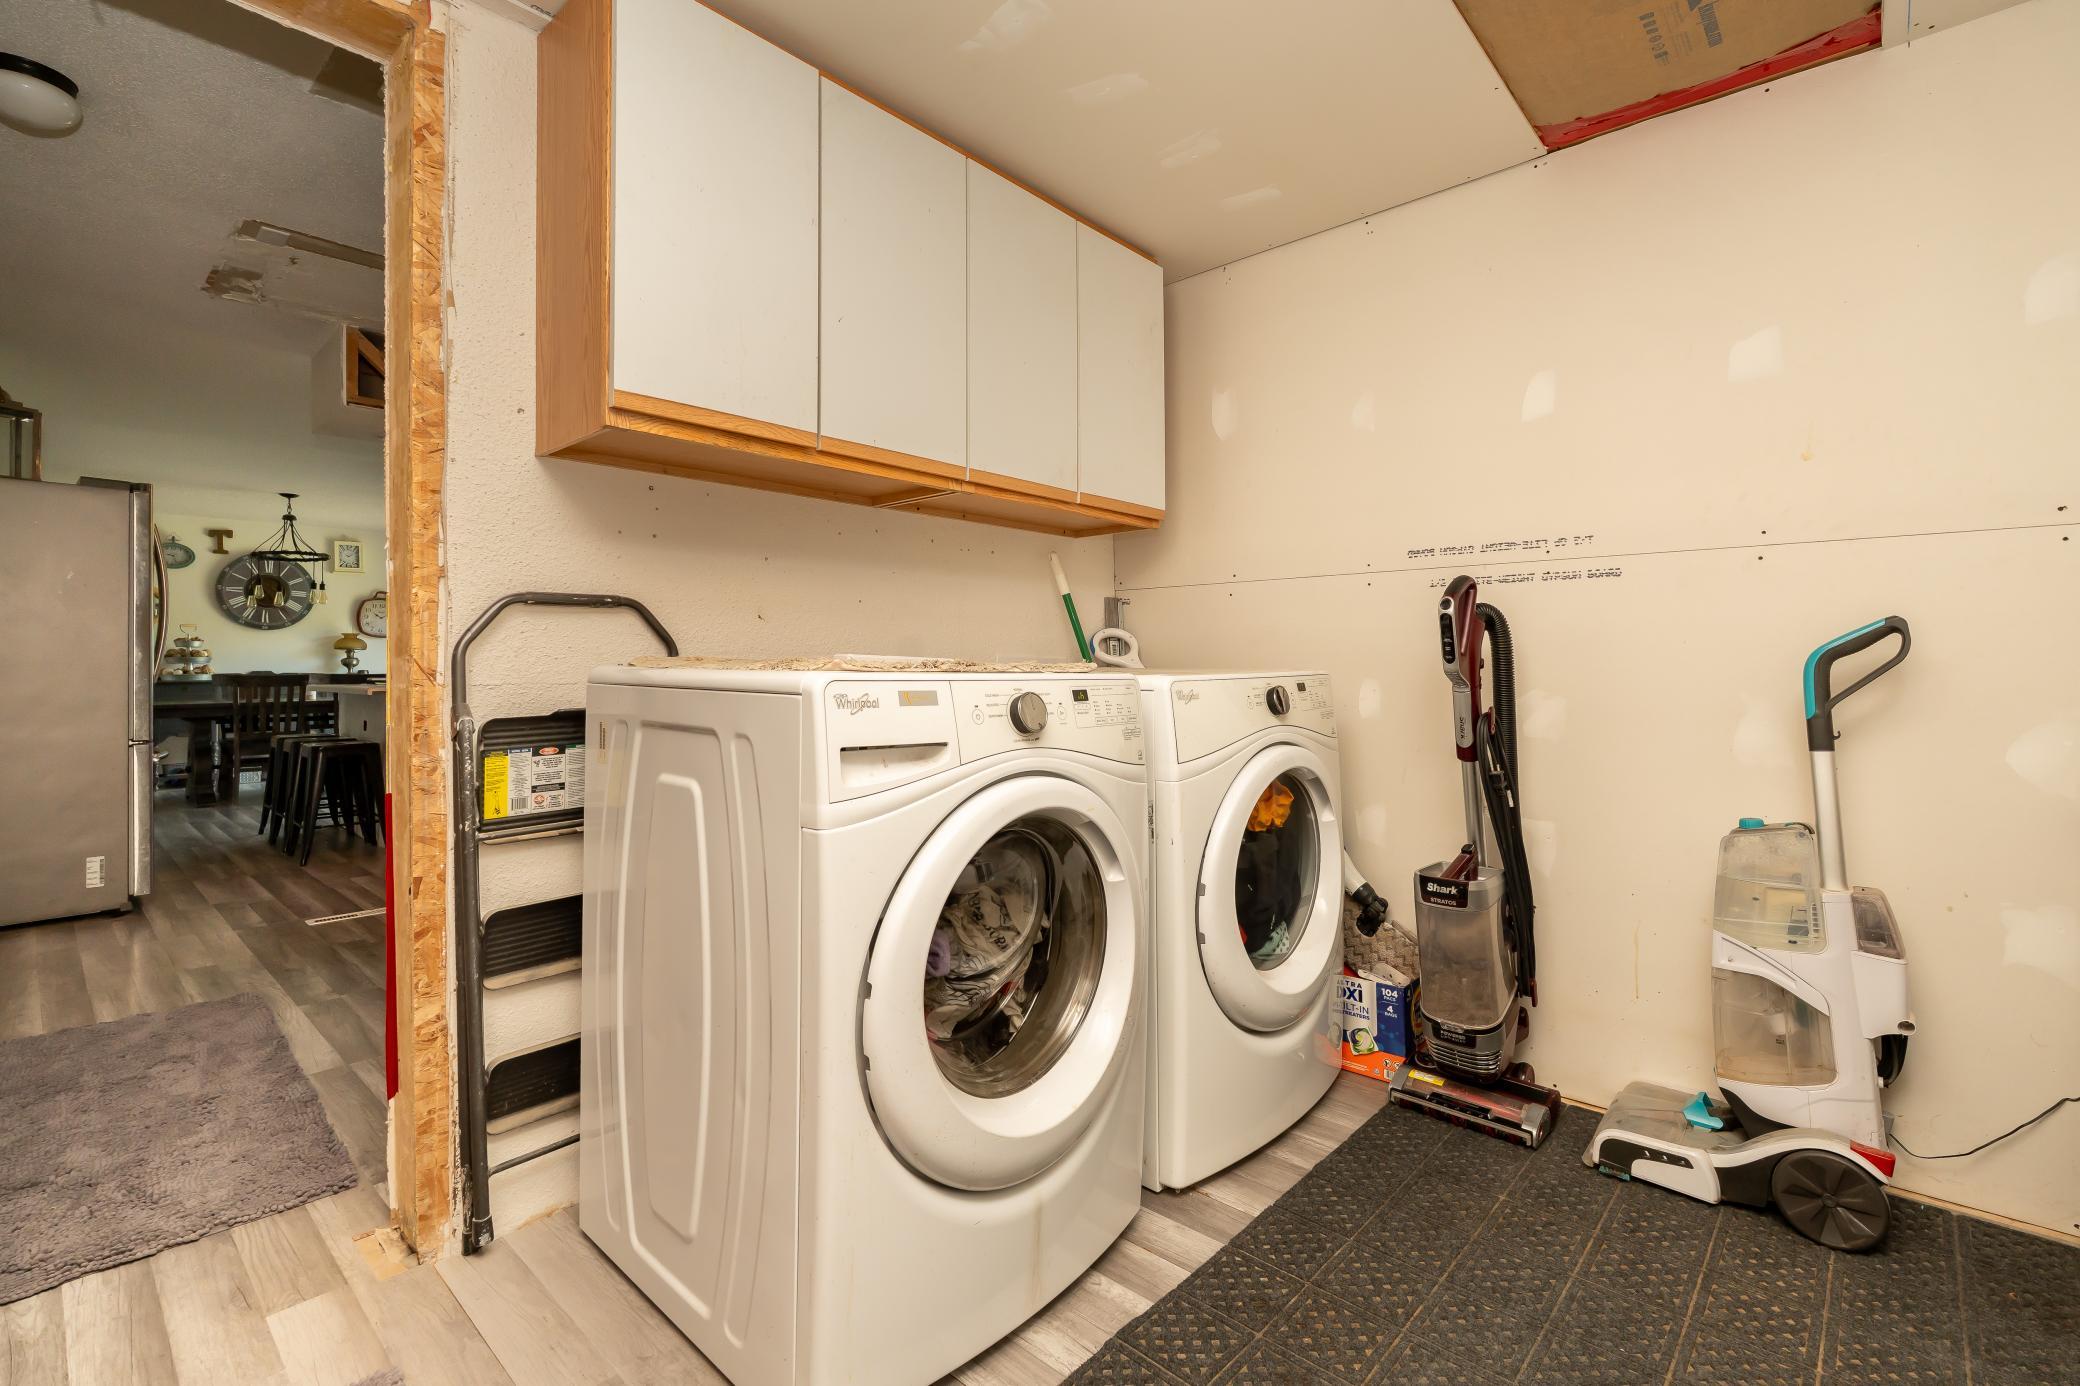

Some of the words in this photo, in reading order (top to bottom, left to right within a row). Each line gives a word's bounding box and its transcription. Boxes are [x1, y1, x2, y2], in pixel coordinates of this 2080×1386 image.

[834, 694, 880, 714] Whirlpool
[1426, 882, 1458, 895] Shark
[1430, 896, 1457, 906] STRATOS
[1345, 980, 1362, 989] TRA
[1381, 988, 1398, 999] 104
[1343, 1001, 1369, 1015] ILT-IN
[1386, 1005, 1394, 1013] 4
